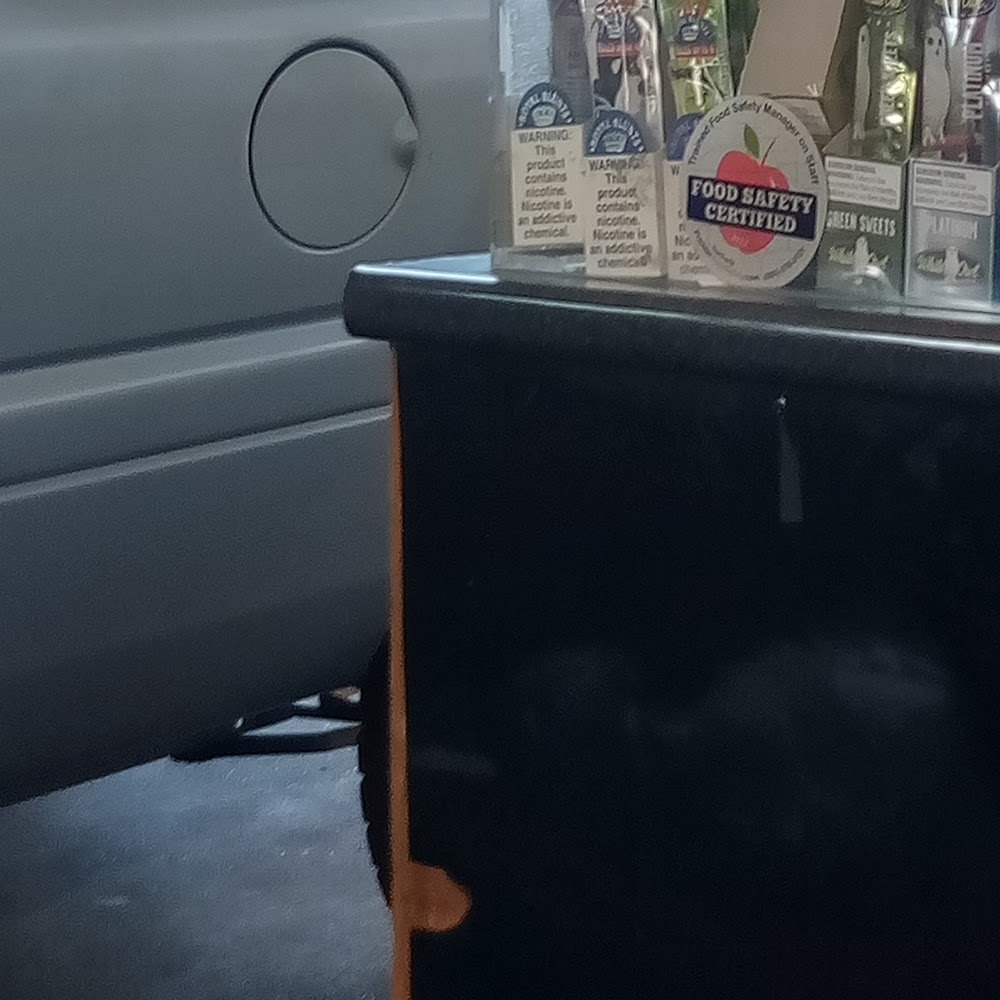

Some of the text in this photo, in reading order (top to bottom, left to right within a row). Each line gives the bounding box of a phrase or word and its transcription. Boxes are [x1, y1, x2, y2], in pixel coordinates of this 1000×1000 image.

[535, 145, 556, 156] This
[527, 160, 565, 174] product
[525, 172, 567, 185] contains
[605, 173, 628, 184] This
[690, 179, 814, 214] FOOD SAFETY
[521, 198, 573, 212] Nicotine is
[518, 217, 530, 226] an
[704, 203, 798, 233] CERTIFIED
[592, 228, 647, 241] Nicotine is
[590, 245, 603, 254] an
